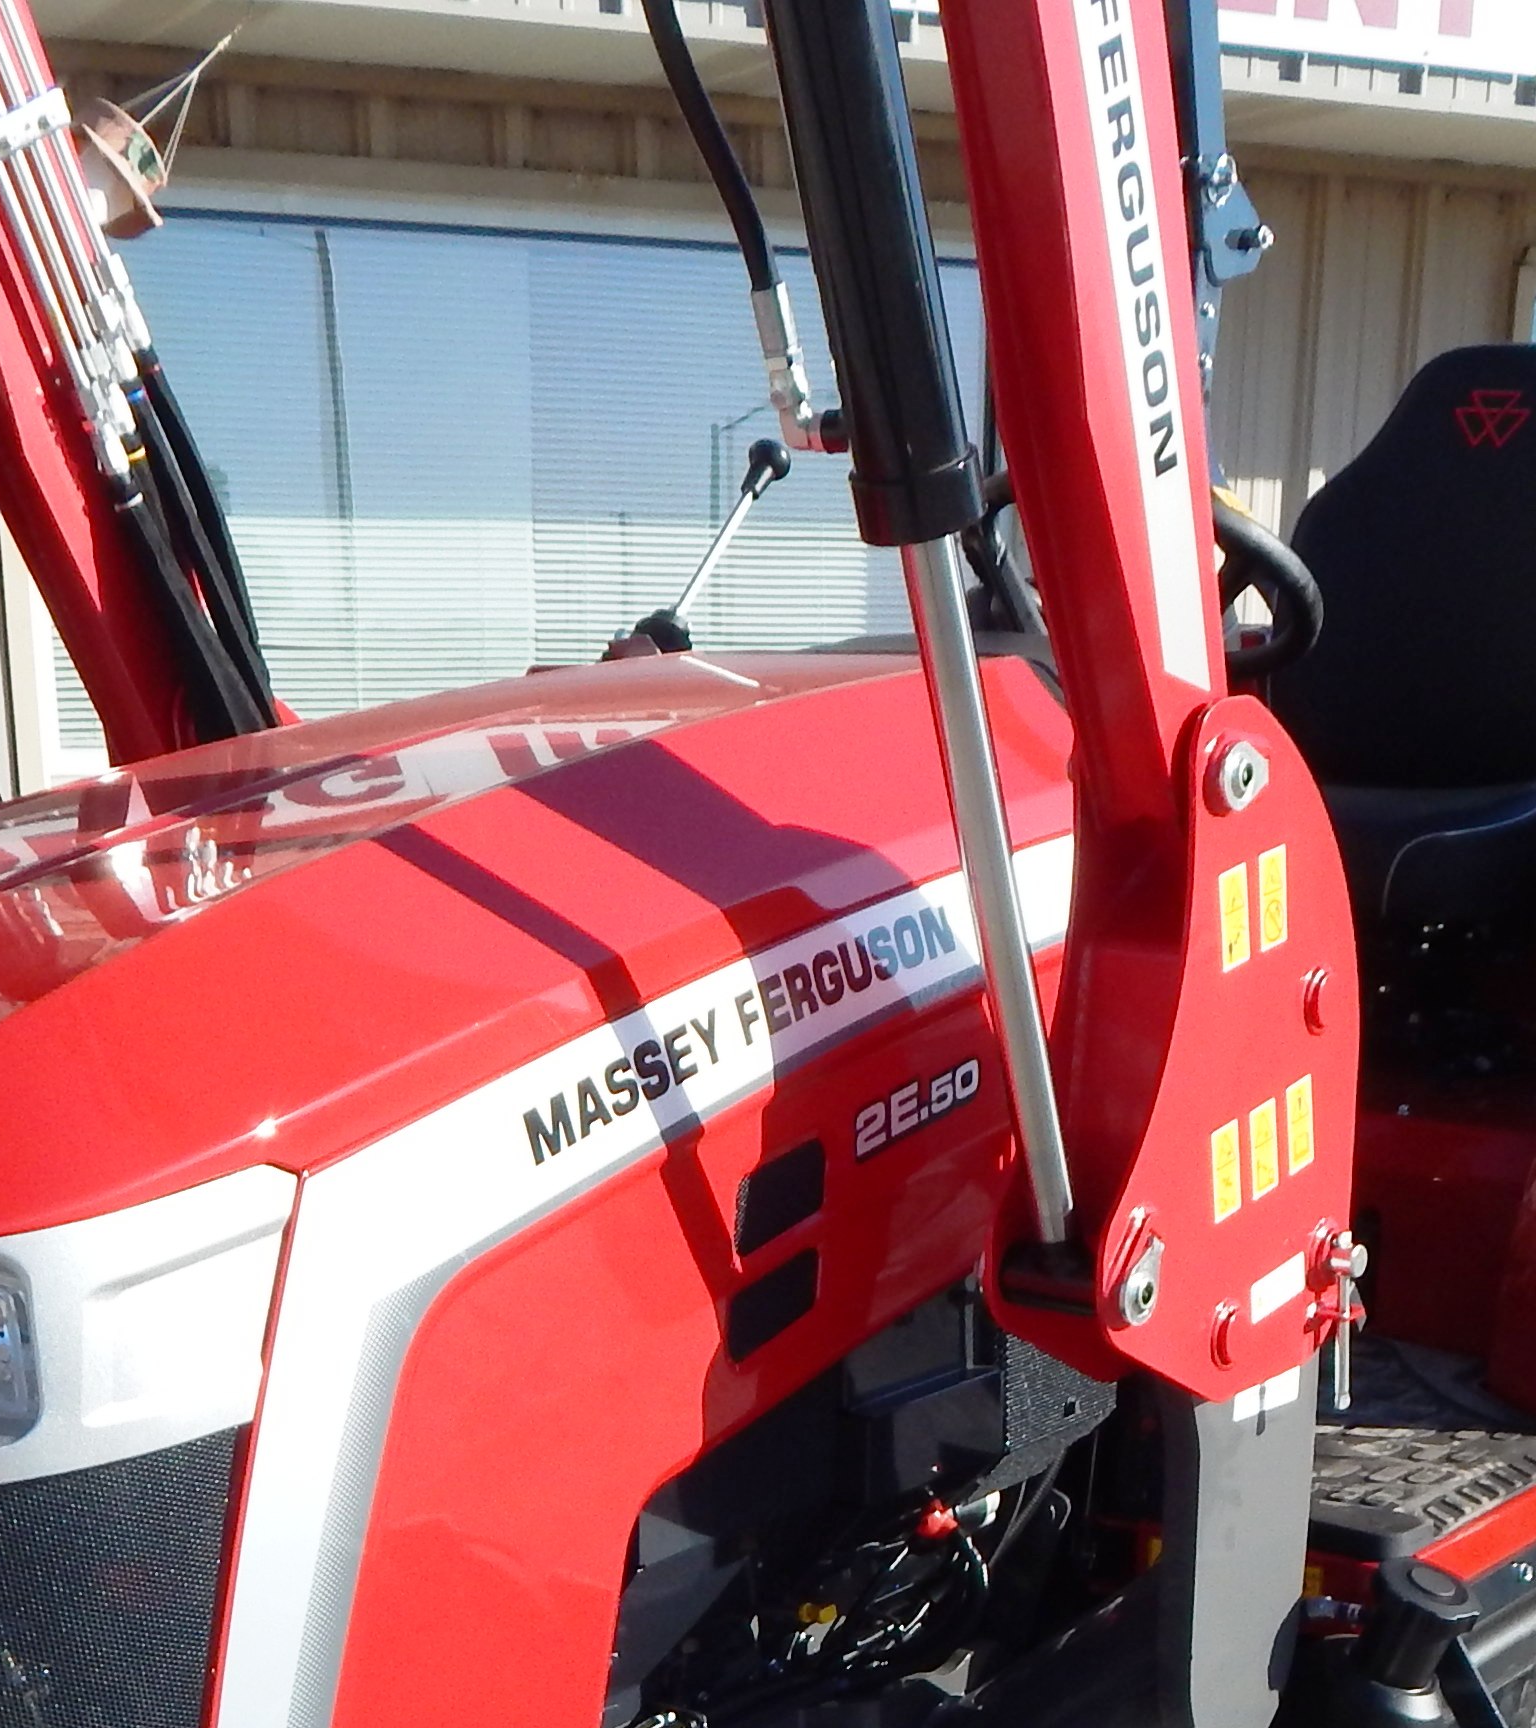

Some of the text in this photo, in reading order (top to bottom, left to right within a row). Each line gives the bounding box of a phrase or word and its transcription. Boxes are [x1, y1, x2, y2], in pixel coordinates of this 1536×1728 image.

[522, 905, 957, 1167] MASSEY FERGUSON
[854, 1057, 981, 1158] 2E.50
